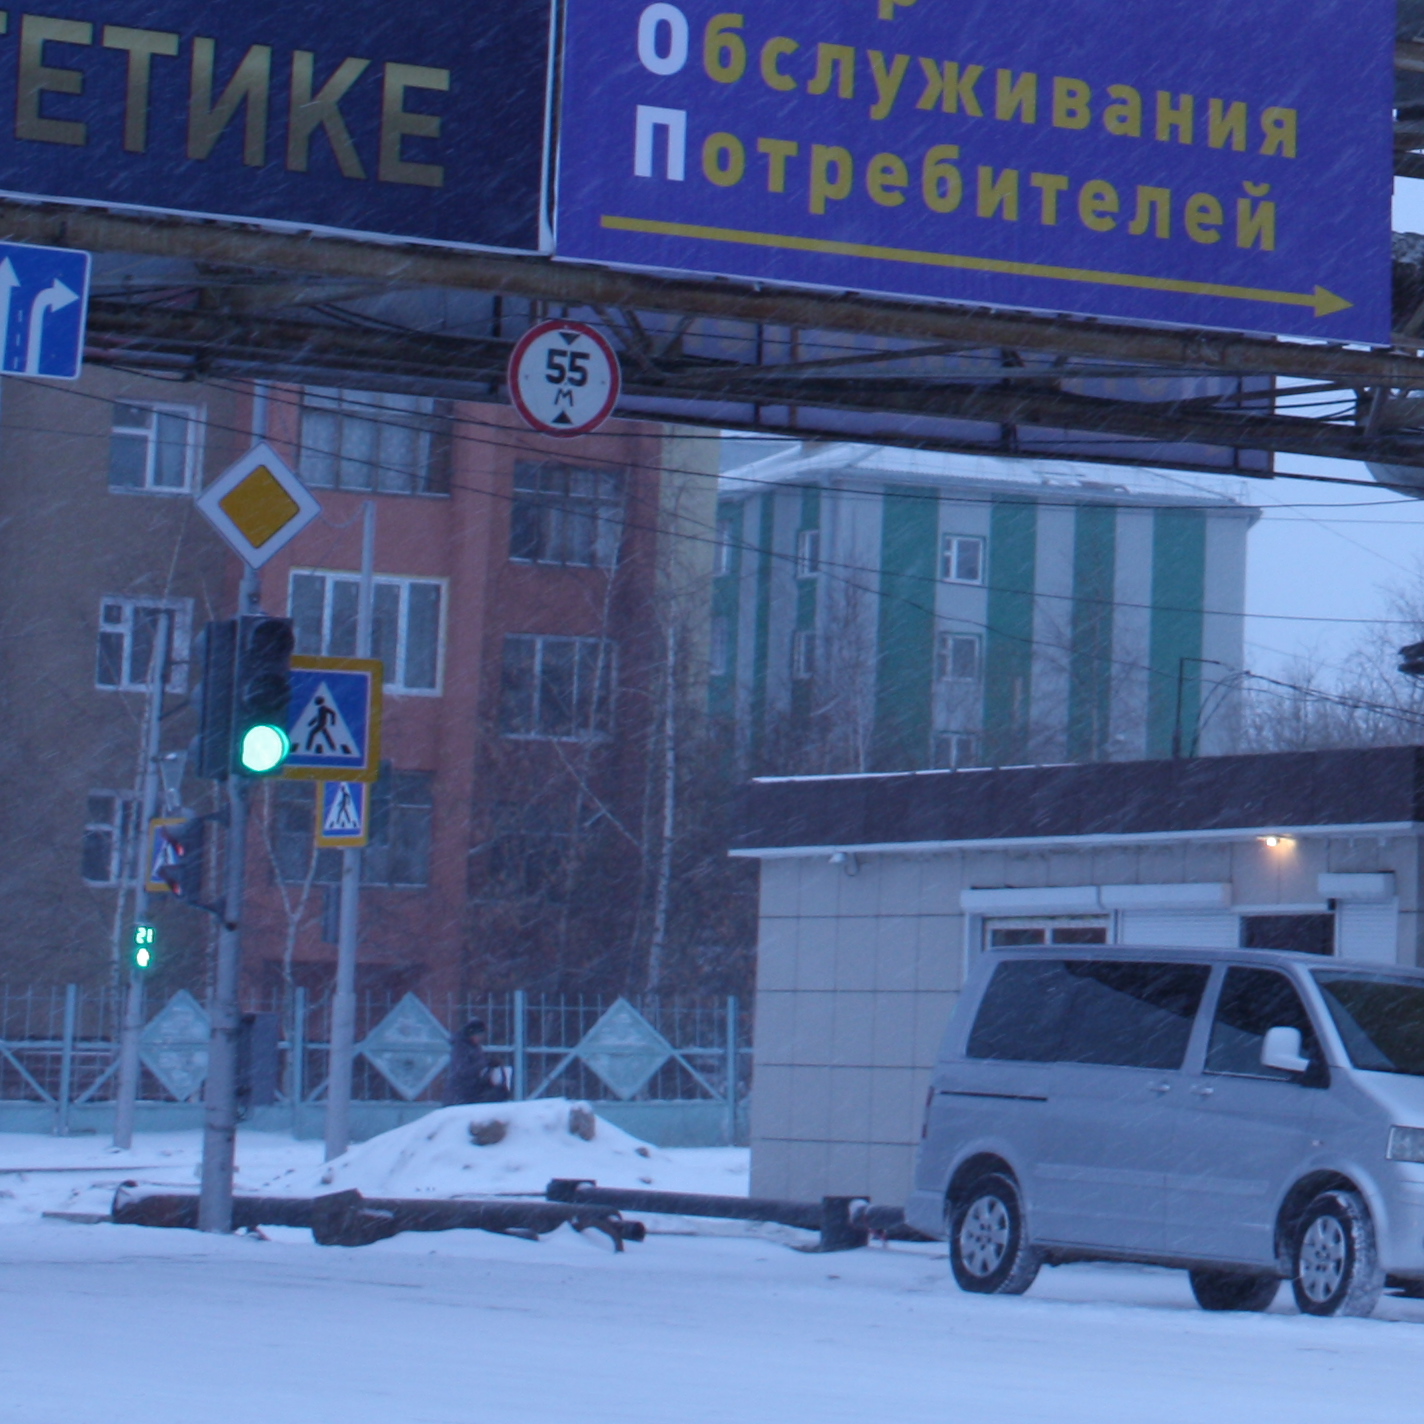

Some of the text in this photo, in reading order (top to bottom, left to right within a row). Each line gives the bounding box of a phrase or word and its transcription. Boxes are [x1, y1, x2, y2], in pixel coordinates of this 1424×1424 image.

[0, 10, 451, 188] ЕТИКЕ
[637, 2, 1298, 159] Обслуживания
[634, 104, 1277, 251] Потребителей
